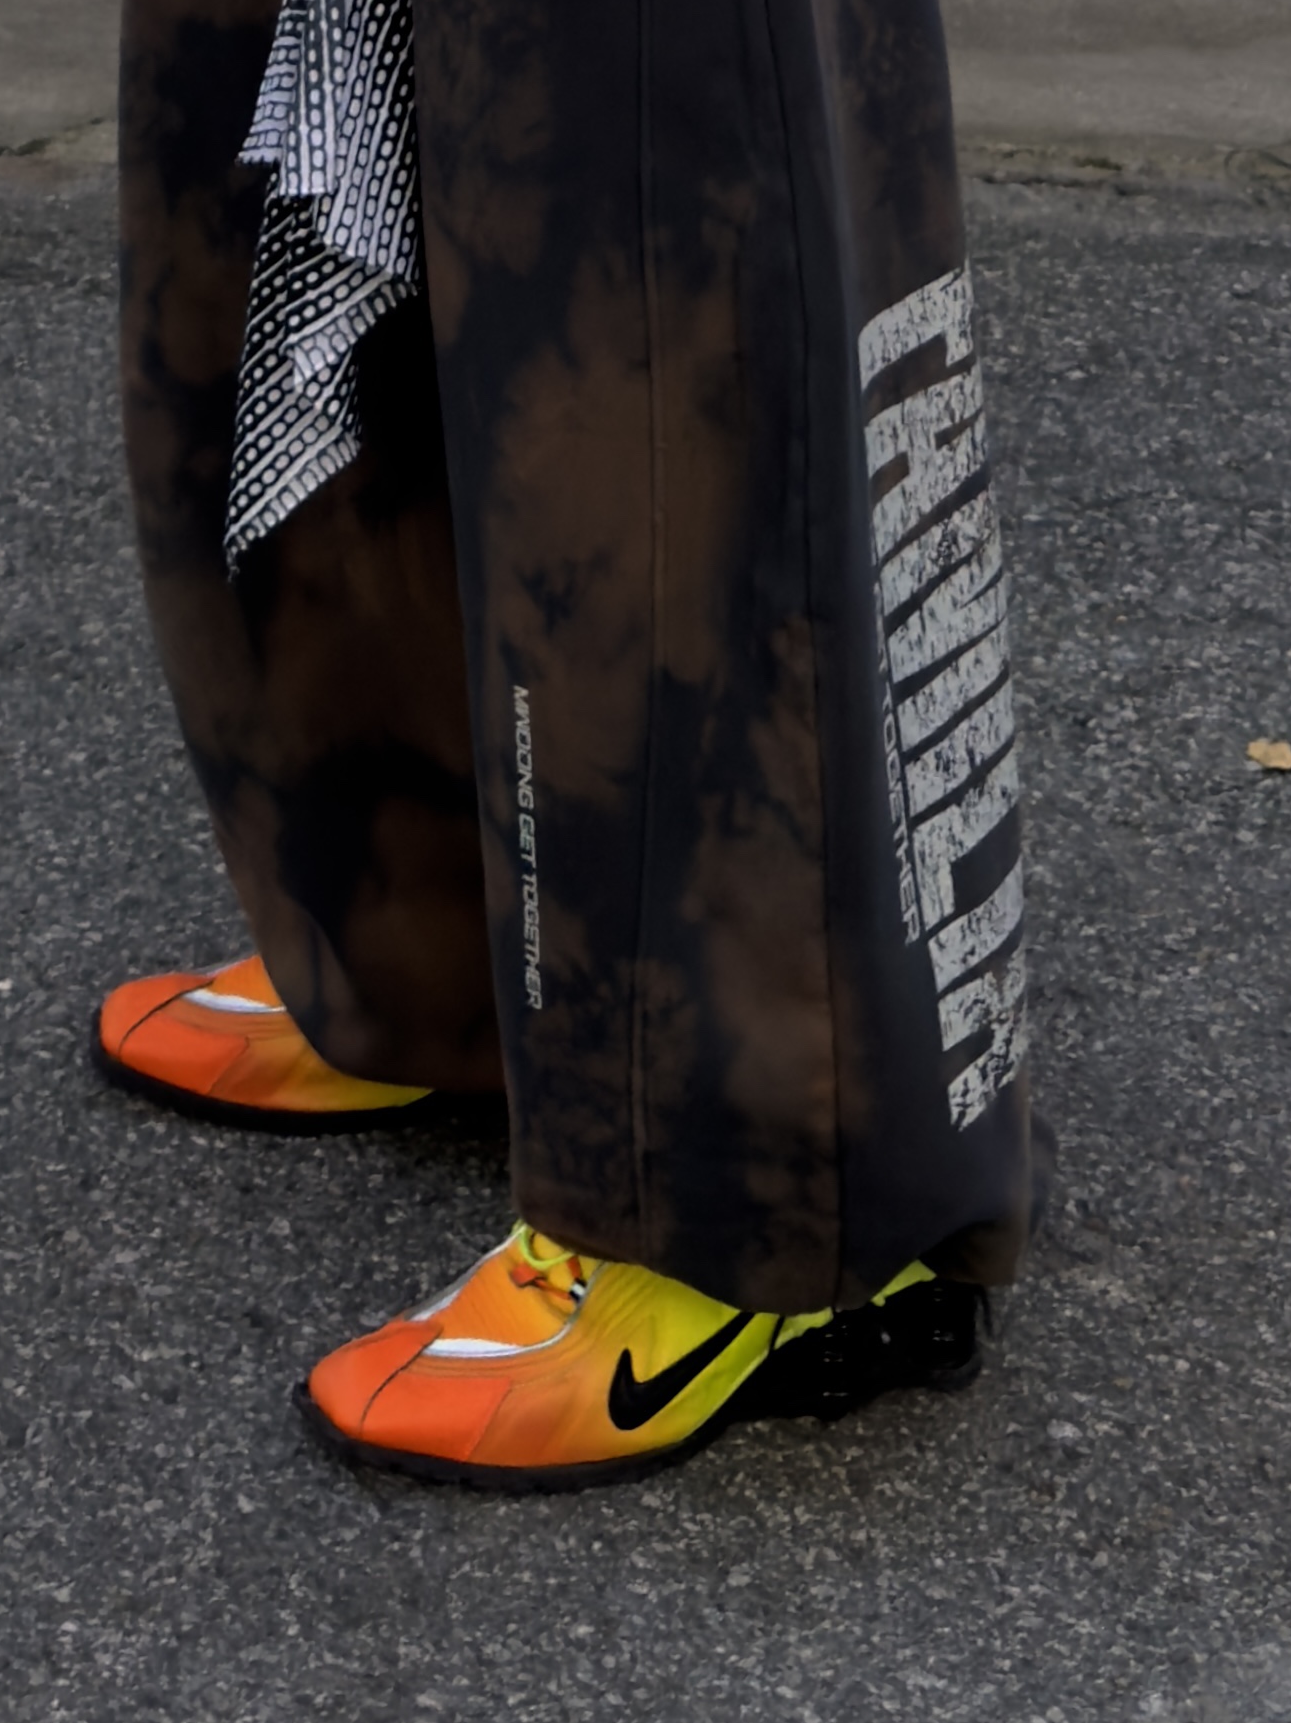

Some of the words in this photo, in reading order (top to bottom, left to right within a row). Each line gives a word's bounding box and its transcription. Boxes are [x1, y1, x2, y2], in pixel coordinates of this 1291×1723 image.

[519, 812, 537, 870] GET
[882, 680, 921, 946] TOGETHER
[522, 871, 543, 1011] TOGETHER
